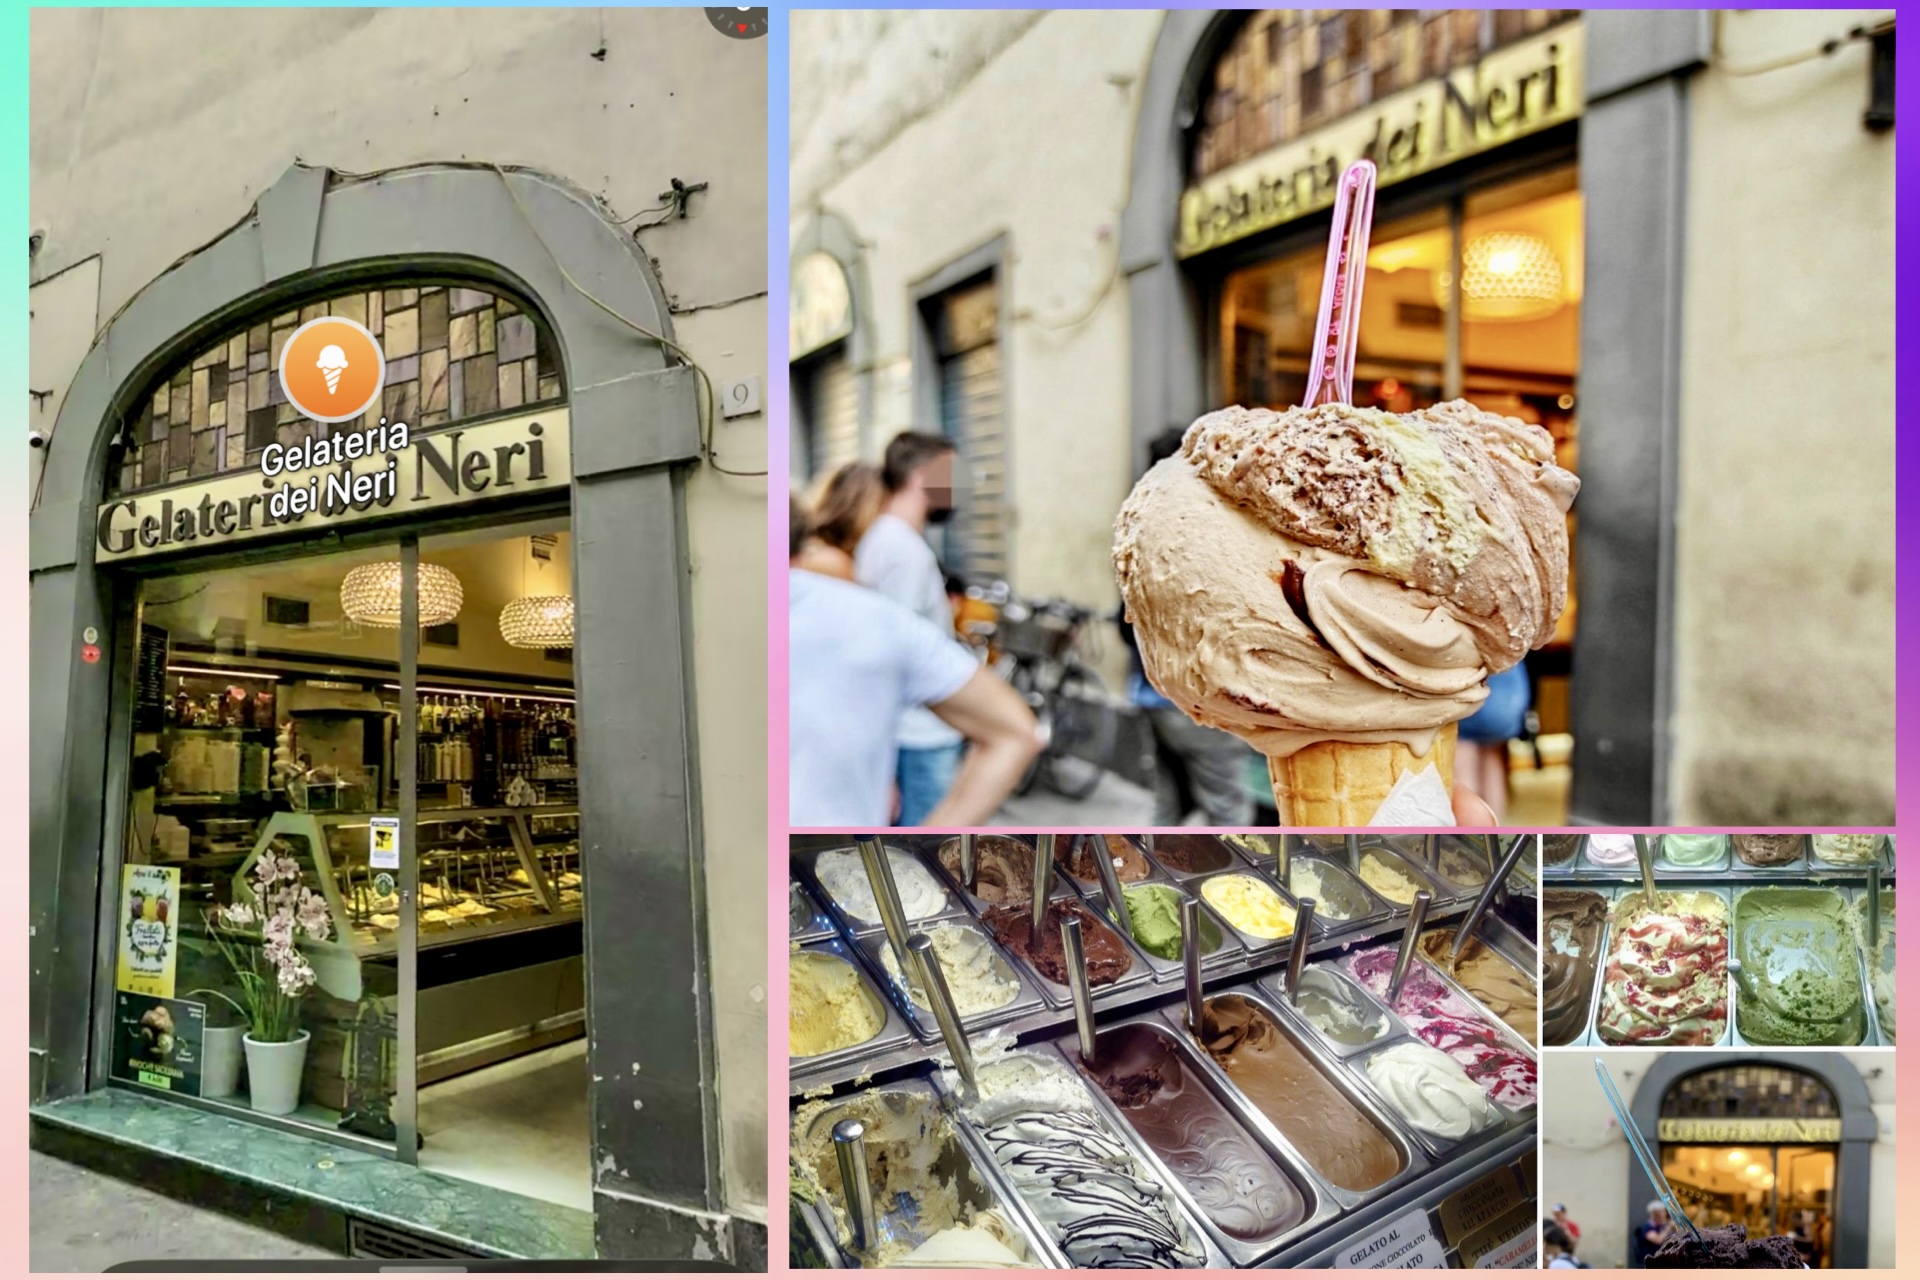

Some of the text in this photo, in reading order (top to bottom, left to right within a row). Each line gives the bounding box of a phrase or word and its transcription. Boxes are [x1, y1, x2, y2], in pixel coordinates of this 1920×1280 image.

[1442, 43, 1563, 154] Neri
[733, 383, 749, 408] 9
[409, 422, 548, 502] Neri
[1350, 1229, 1401, 1265] GELATO AL
[1387, 1233, 1426, 1264] CIOCCOLATO
